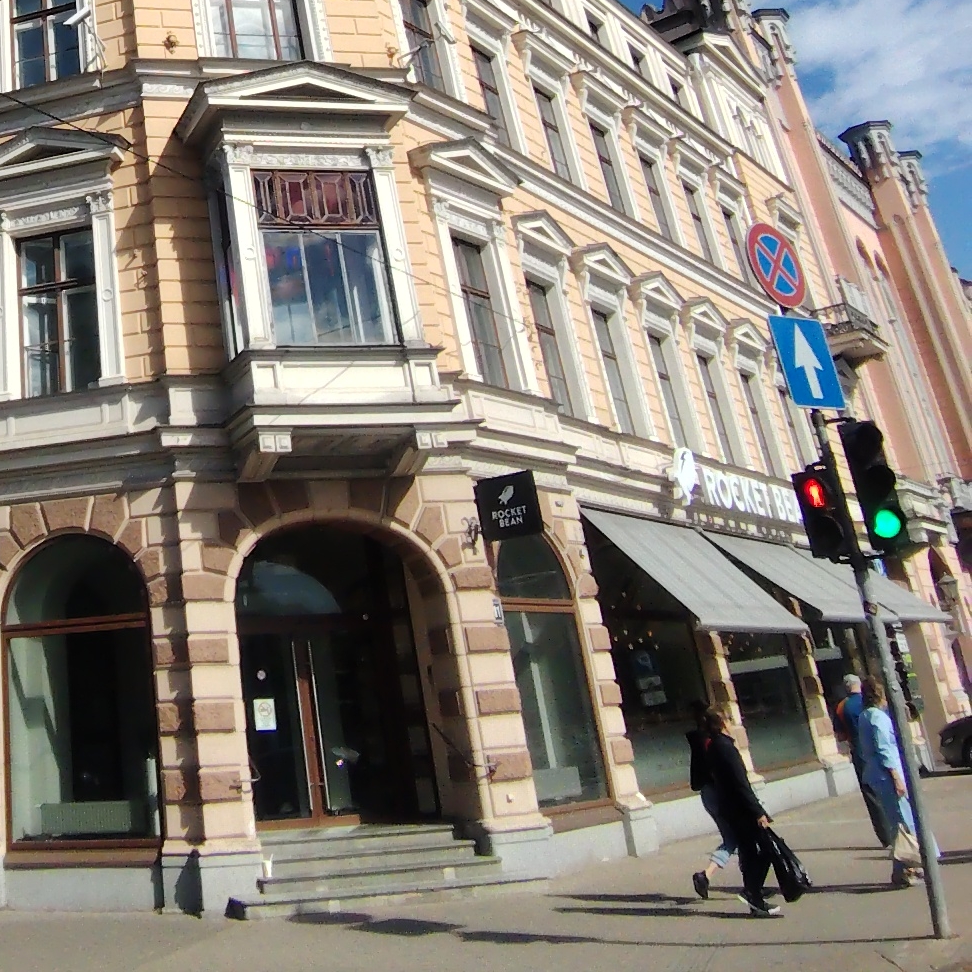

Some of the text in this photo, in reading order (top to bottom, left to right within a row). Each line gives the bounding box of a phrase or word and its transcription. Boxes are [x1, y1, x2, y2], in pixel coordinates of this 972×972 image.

[701, 467, 773, 519] ROCKET
[491, 505, 527, 520] ROCKET
[499, 515, 524, 528] BEAN
